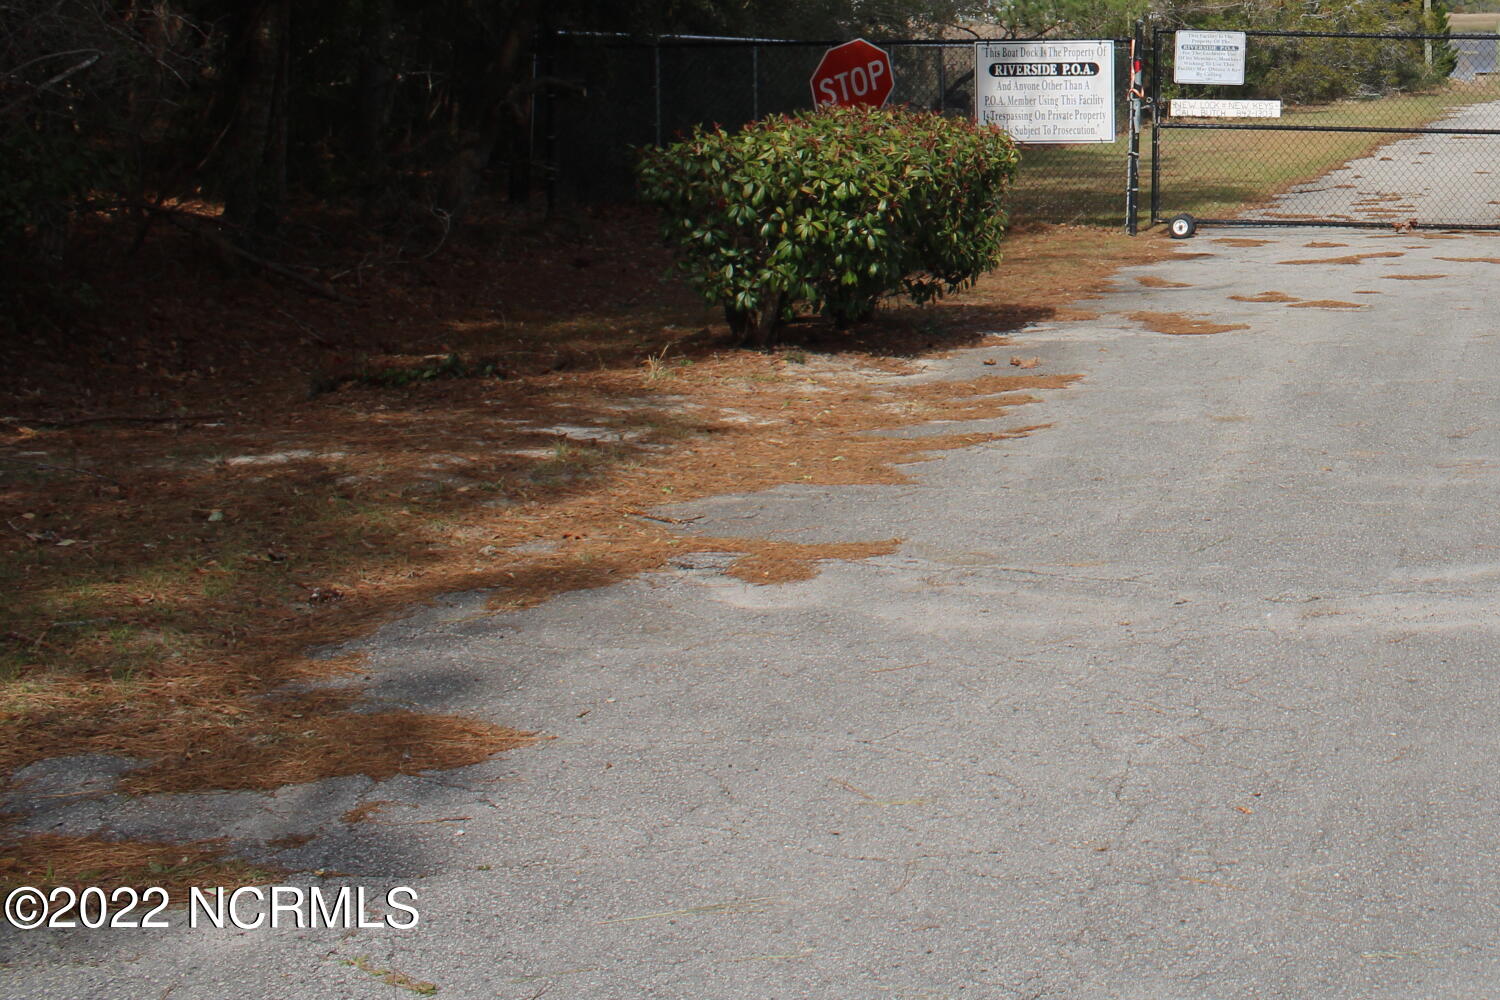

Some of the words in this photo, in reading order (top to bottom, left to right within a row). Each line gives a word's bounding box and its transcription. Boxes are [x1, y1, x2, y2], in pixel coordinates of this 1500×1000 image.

[1002, 47, 1018, 58] Boat
[1020, 47, 1039, 58] Dock
[1040, 47, 1047, 57] Is
[1048, 47, 1062, 57] The
[1063, 47, 1094, 60] Property
[1097, 46, 1107, 56] Of
[994, 64, 1057, 76] RIVERSIDE
[1062, 63, 1094, 75] P.O.A.
[819, 60, 884, 107] STOP
[997, 81, 1011, 91] And
[1014, 81, 1039, 93] Anyone
[1041, 80, 1063, 91] Other
[1064, 80, 1082, 90] Than
[1084, 80, 1090, 90] A
[984, 95, 1005, 106] P.O.A.
[1007, 95, 1036, 106] Member
[1038, 94, 1059, 107] Using
[1060, 94, 1077, 104] This
[1078, 94, 1104, 108] Facility
[983, 110, 990, 120] Is
[989, 110, 1033, 124] Trespassing
[1034, 110, 1046, 121] On
[1047, 110, 1073, 121] Private
[1074, 109, 1106, 124] Property
[1014, 125, 1041, 139] Subject
[1041, 125, 1052, 135] To
